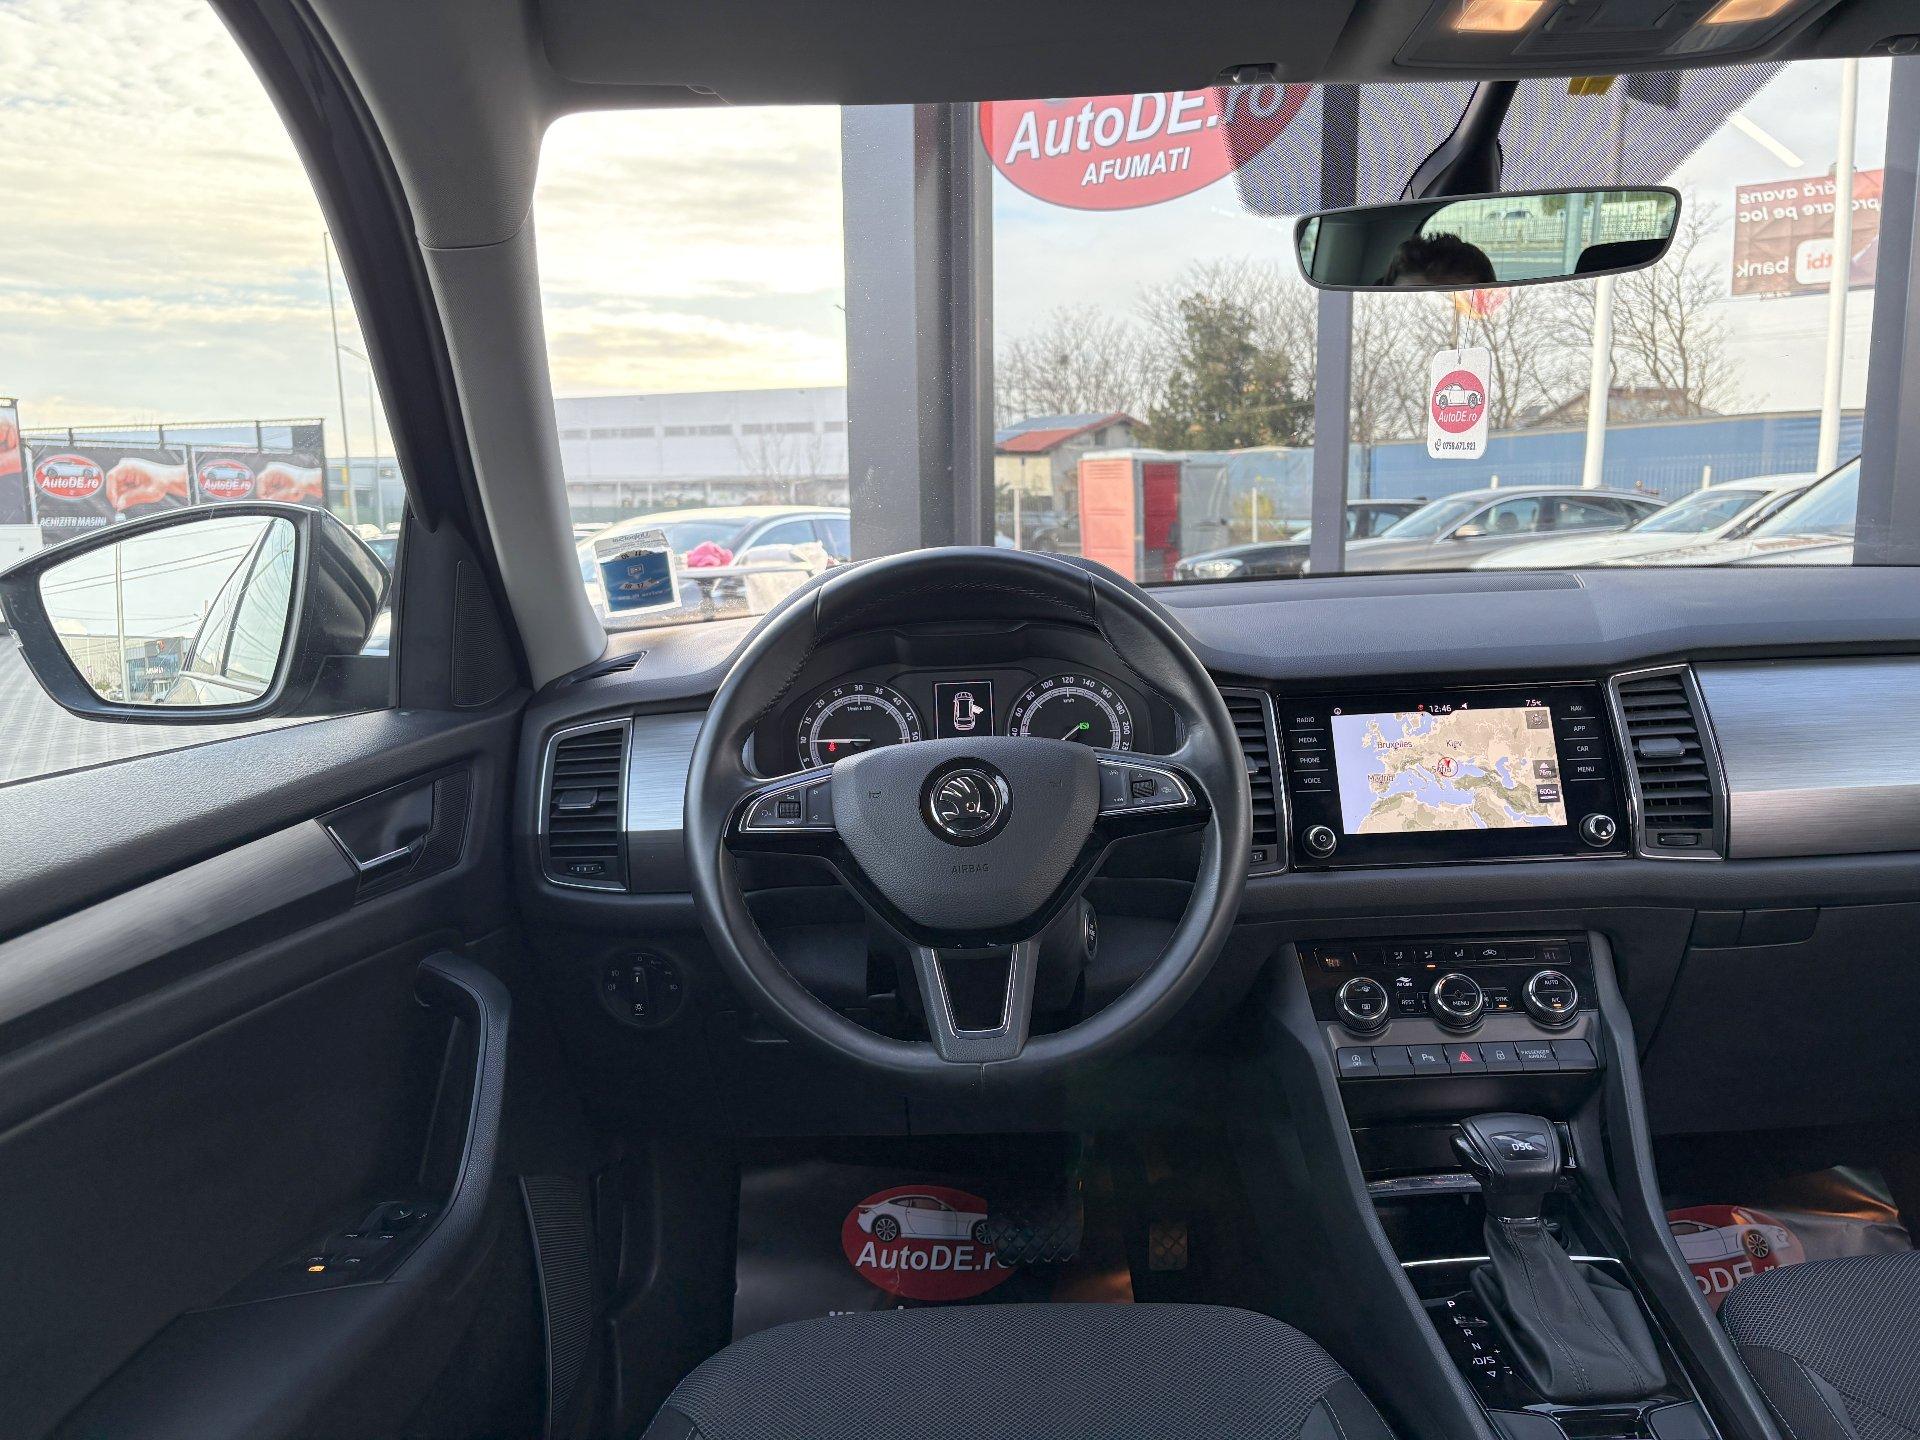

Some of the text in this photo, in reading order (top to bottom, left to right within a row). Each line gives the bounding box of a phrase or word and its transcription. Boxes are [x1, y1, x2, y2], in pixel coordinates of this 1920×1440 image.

[1080, 147, 1191, 187] AFUMATI
[1438, 410, 1477, 423] AutoDE.ro
[41, 475, 99, 489] AutoDE.ro
[1062, 676, 1075, 684] 120
[1082, 678, 1096, 688] 140
[854, 684, 864, 692] 30
[1041, 680, 1054, 690] 100
[833, 688, 843, 697] 25
[874, 686, 884, 695] 35
[1100, 687, 1113, 699] 160
[1026, 691, 1036, 701] 80
[815, 699, 825, 709] 20
[892, 696, 902, 706] 40
[1015, 707, 1024, 718] 60
[1115, 702, 1125, 716] 180
[1429, 704, 1452, 713] 12:46
[804, 717, 812, 725] 15
[905, 712, 914, 721] 45
[1122, 721, 1131, 735] 200
[1377, 741, 1413, 750] Bruxelles
[1446, 739, 1463, 748] Kiev
[1431, 765, 1452, 774] Sofia
[1368, 774, 1394, 783] Madrid
[951, 863, 990, 874] AIRBAG
[1511, 1142, 1534, 1151] DSG
[855, 1241, 1009, 1271] AutoDE.r
[1446, 1300, 1456, 1308] P
[1463, 1328, 1474, 1337] R
[1471, 1342, 1482, 1350] N
